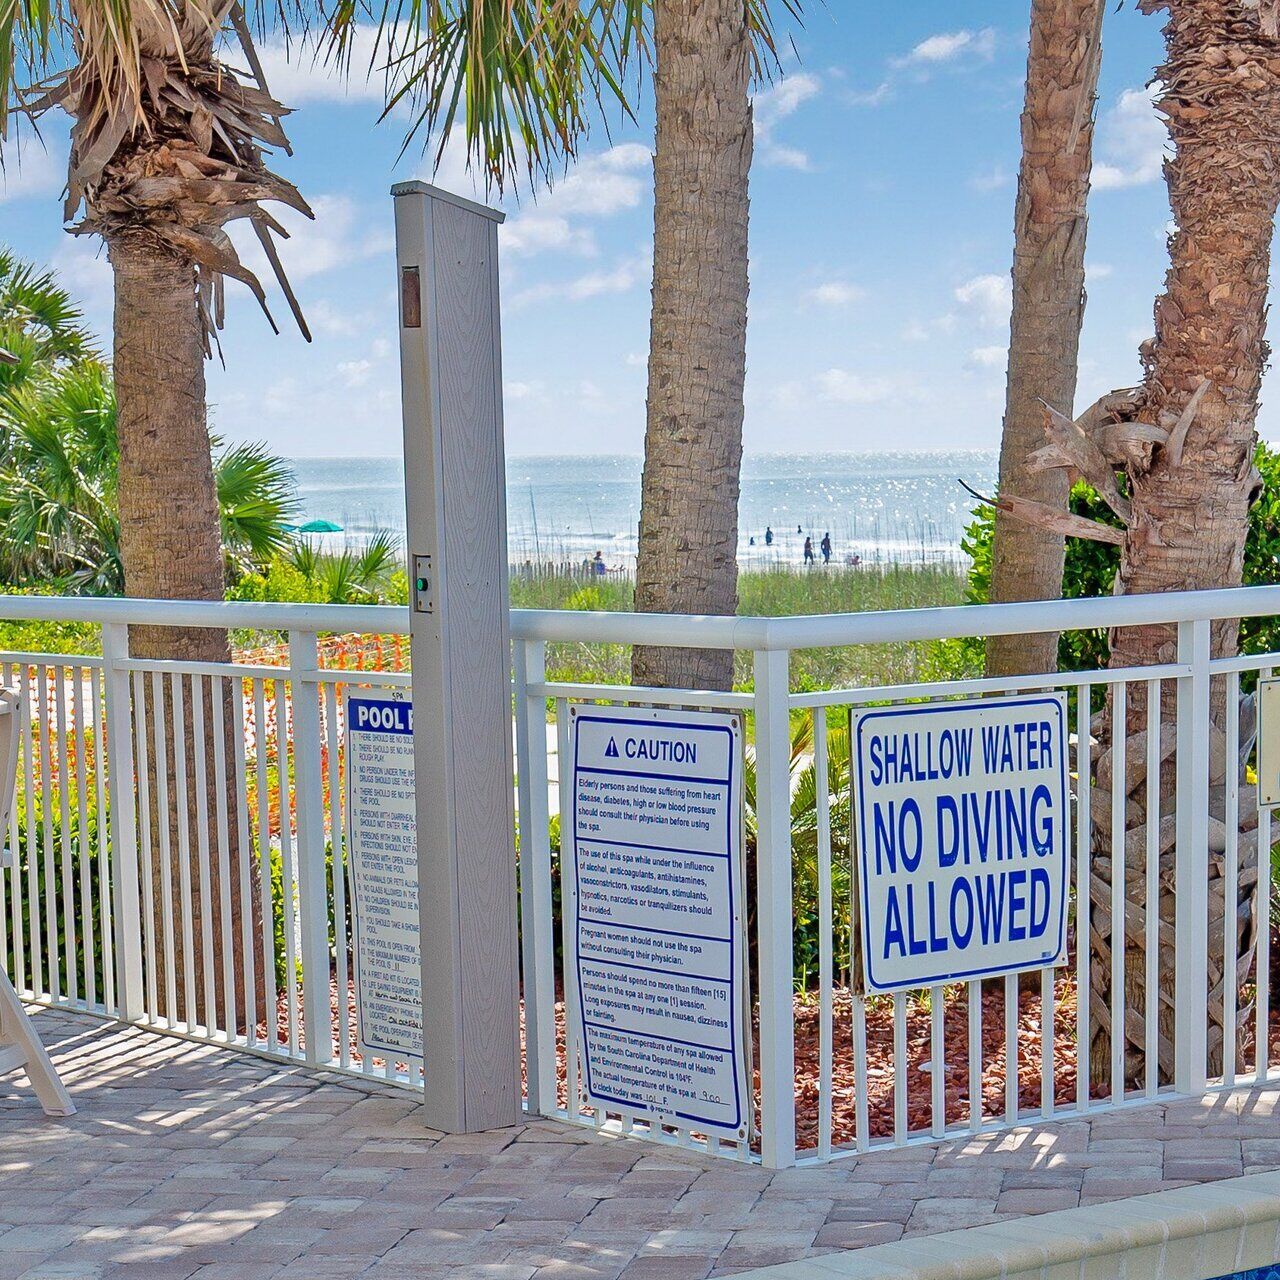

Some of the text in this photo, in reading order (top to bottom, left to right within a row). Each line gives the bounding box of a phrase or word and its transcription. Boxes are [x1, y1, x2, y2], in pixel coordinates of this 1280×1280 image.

[358, 706, 404, 730] POOL
[625, 738, 696, 764] CAUTION
[870, 721, 1052, 786] SHALLOW WATER
[578, 778, 721, 800] Elderly persons and those suffering from heart
[578, 792, 602, 803] disease,
[603, 795, 631, 806] diabetes,
[632, 798, 647, 809] high
[656, 801, 666, 809] low
[668, 802, 686, 811] blood
[687, 805, 716, 816] pressure
[578, 806, 710, 830] should consult their physician before using
[578, 820, 601, 832] the spa.
[874, 784, 1054, 875] NO DIVING
[579, 847, 589, 856] The
[602, 850, 608, 859] of
[609, 851, 621, 860] this
[622, 854, 633, 863] spa
[634, 854, 651, 864] while
[652, 856, 670, 866] under
[671, 859, 682, 868] the
[684, 860, 714, 872] influence
[579, 861, 585, 869] of
[586, 862, 608, 873] alcohol,
[657, 871, 706, 887] antihistamines,
[610, 893, 637, 905] narcotics
[647, 898, 687, 913] tranquilizers
[689, 904, 712, 915] should
[671, 888, 708, 901] stimulants,
[581, 903, 587, 912] be
[884, 868, 1052, 960] ALLOWED
[580, 927, 701, 954] Pregnant women should not use the spa
[580, 941, 683, 966] without consulting their physician.
[581, 967, 606, 979] Persons
[607, 971, 627, 982] should
[628, 975, 647, 987] spend
[658, 981, 674, 990] more
[675, 983, 689, 993] than
[690, 985, 711, 996] fifteen
[607, 985, 613, 993] in
[614, 986, 623, 995] the
[625, 989, 635, 999] spa
[637, 990, 643, 999] at
[644, 993, 655, 1002] any
[656, 995, 668, 1003] one
[679, 998, 706, 1010] session.
[584, 994, 728, 1027] Long exposures may result in nausea, dizziness
[587, 1027, 598, 1037] The
[628, 1035, 665, 1052] temperature
[666, 1043, 672, 1052] of
[673, 1046, 685, 1056] any
[685, 1048, 697, 1058] spa
[698, 1049, 723, 1062] allowed
[589, 1040, 715, 1075] by the South Carolina Department of Health
[590, 1054, 600, 1064] and
[601, 1056, 643, 1073] Environmental
[644, 1066, 668, 1078] Control
[669, 1071, 674, 1080] is
[591, 1068, 602, 1077] The
[603, 1070, 619, 1081] actual
[620, 1073, 657, 1090] temperature
[658, 1081, 664, 1090] of
[666, 1083, 677, 1093] this
[678, 1087, 689, 1097] spa
[690, 1088, 696, 1097] at
[612, 1086, 629, 1098] today
[630, 1091, 642, 1100] was
